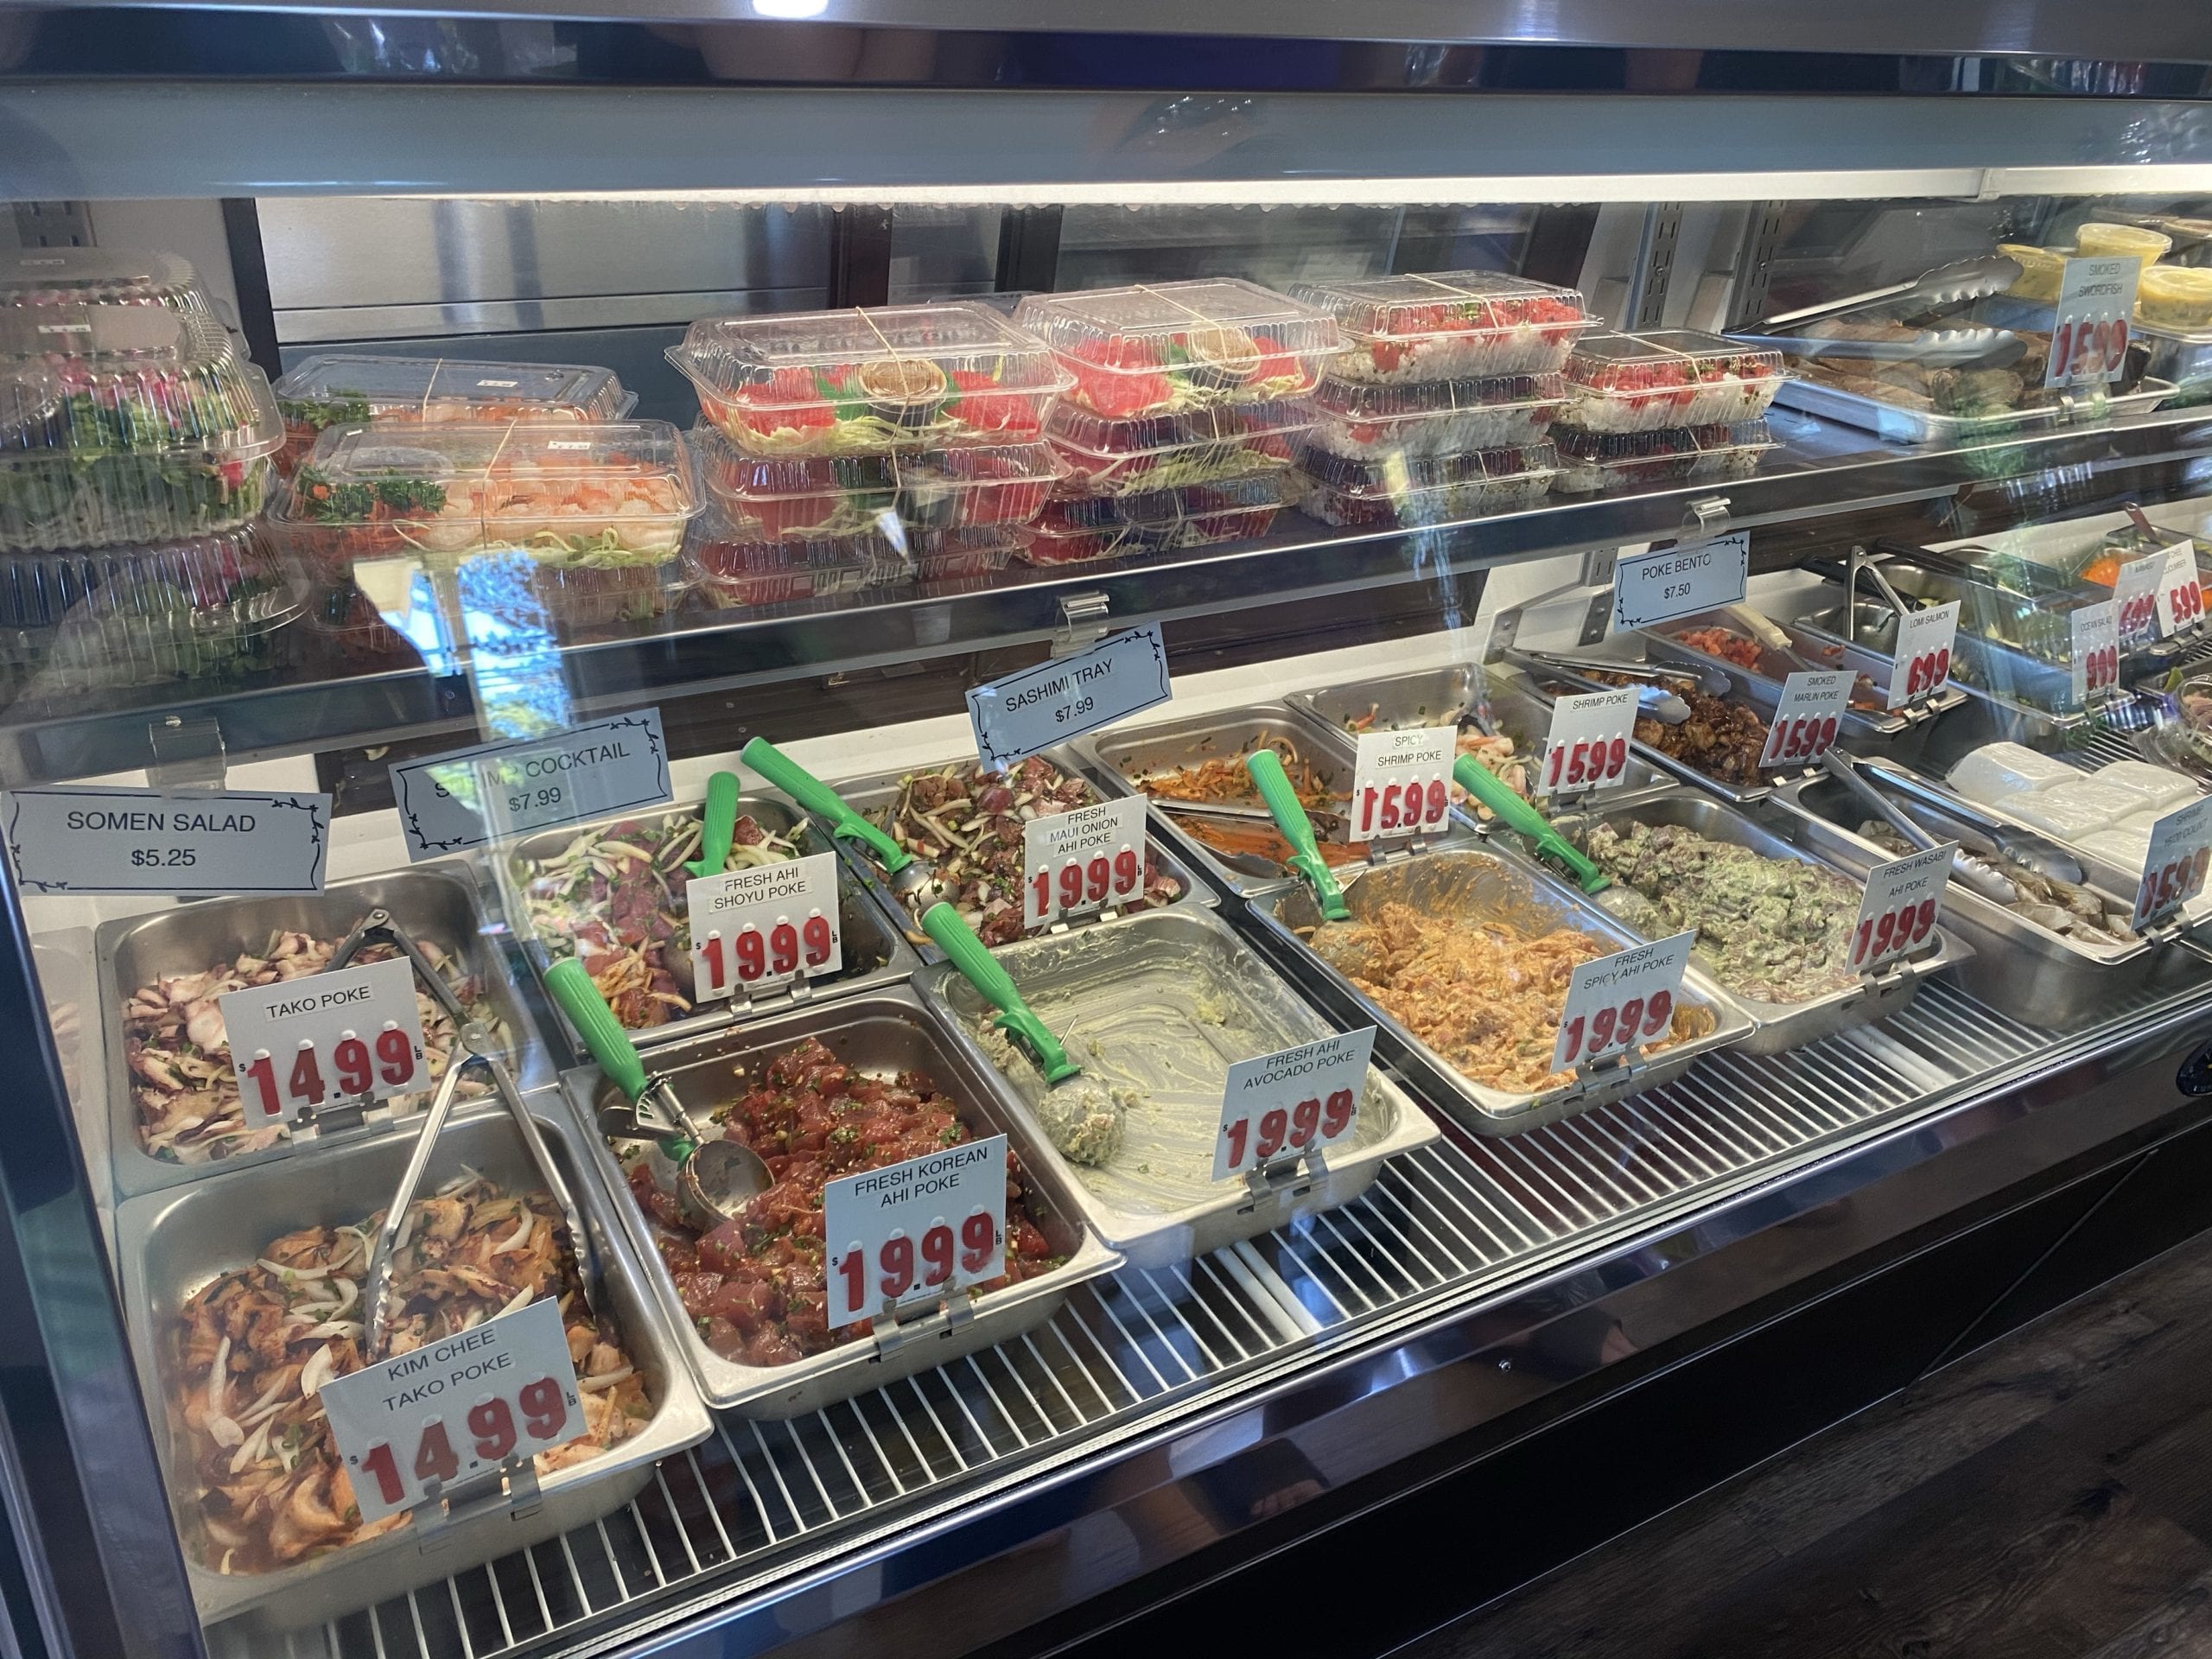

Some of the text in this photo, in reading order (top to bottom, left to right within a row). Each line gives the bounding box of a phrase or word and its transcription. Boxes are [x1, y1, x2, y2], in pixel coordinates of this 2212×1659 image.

[2088, 263, 2120, 276] SMOKED
[2078, 283, 2123, 298] SWORDFISH
[1642, 554, 1712, 581] POKE BENTO
[1663, 583, 1691, 600] $7.50
[1910, 610, 1949, 629] LOMI SALMON
[1006, 658, 1113, 713] SASHIMI TRAY
[1807, 676, 1836, 686] SMOKED
[1573, 694, 1629, 710] SHRIMP POKE
[1794, 690, 1839, 702] MARLIN POKE
[1055, 696, 1094, 723] $7.99
[1395, 735, 1424, 747] SPICY
[435, 741, 630, 798] SIMP COCKTAIL
[1377, 750, 1442, 767] SHRIMP POKE
[509, 787, 562, 813] $7.99
[67, 811, 256, 833] SOMEN SALAD
[1067, 806, 1106, 824] FRESH
[1050, 817, 1118, 843] MAUI ONION
[1058, 832, 1111, 855] AHI POKE
[130, 849, 196, 867] $5.25
[1884, 850, 1947, 879] FRESH WASABI
[725, 868, 798, 892] FRESH AHI
[1888, 876, 1929, 898] AHI POKE
[715, 881, 806, 909] SHOYU POKE
[1614, 948, 1654, 968] FRESH
[1584, 955, 1675, 989] SPICY AHI POKE
[266, 986, 371, 1019] TAKO POKE
[1266, 1039, 1340, 1070] FRESH AHI
[1243, 1050, 1355, 1090] AVOCADO POKE
[855, 1147, 988, 1196] FRESH KOREAN
[881, 1173, 960, 1208] AHI POKE
[388, 1329, 496, 1381] KIM CHEE
[382, 1352, 512, 1411] TAKO POKE
